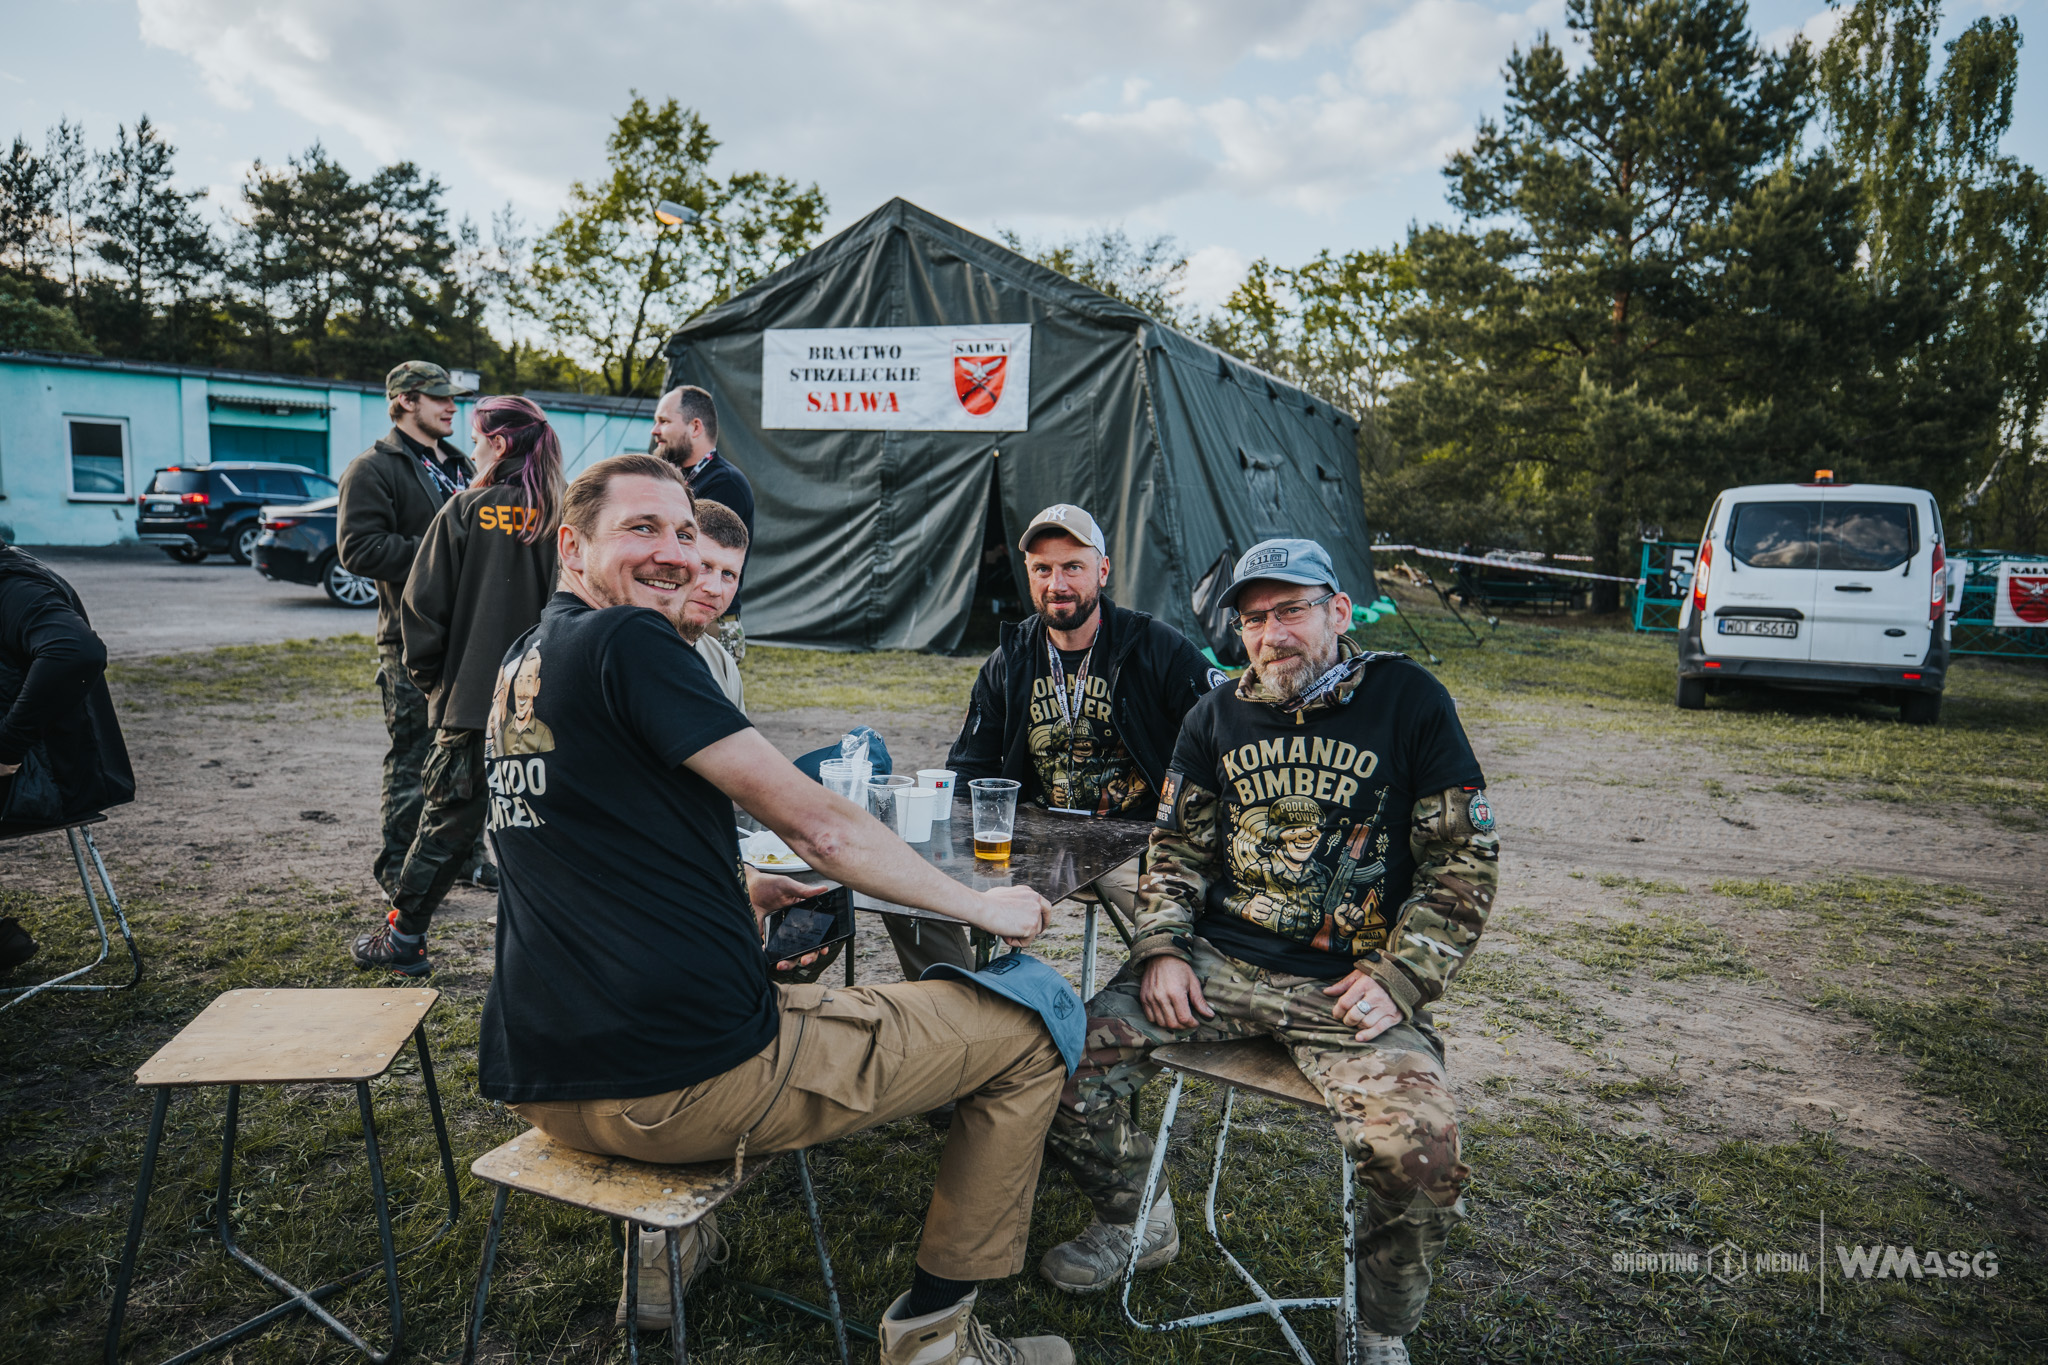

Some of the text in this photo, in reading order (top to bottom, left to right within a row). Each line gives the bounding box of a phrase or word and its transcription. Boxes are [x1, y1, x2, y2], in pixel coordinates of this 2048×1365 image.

[808, 345, 902, 361] BRACTWO
[955, 342, 1008, 355] SALWA
[790, 367, 921, 382] STRZELECKIE
[806, 391, 901, 413] SALWA
[479, 505, 538, 536] SĘDZ
[1726, 621, 1796, 636] WOT 4561A
[1031, 673, 1112, 704] OAND
[1222, 736, 1379, 781] KOMANDO
[485, 757, 547, 796] ANDO
[1233, 768, 1359, 807] BIMBER
[1288, 813, 1320, 824] POWER
